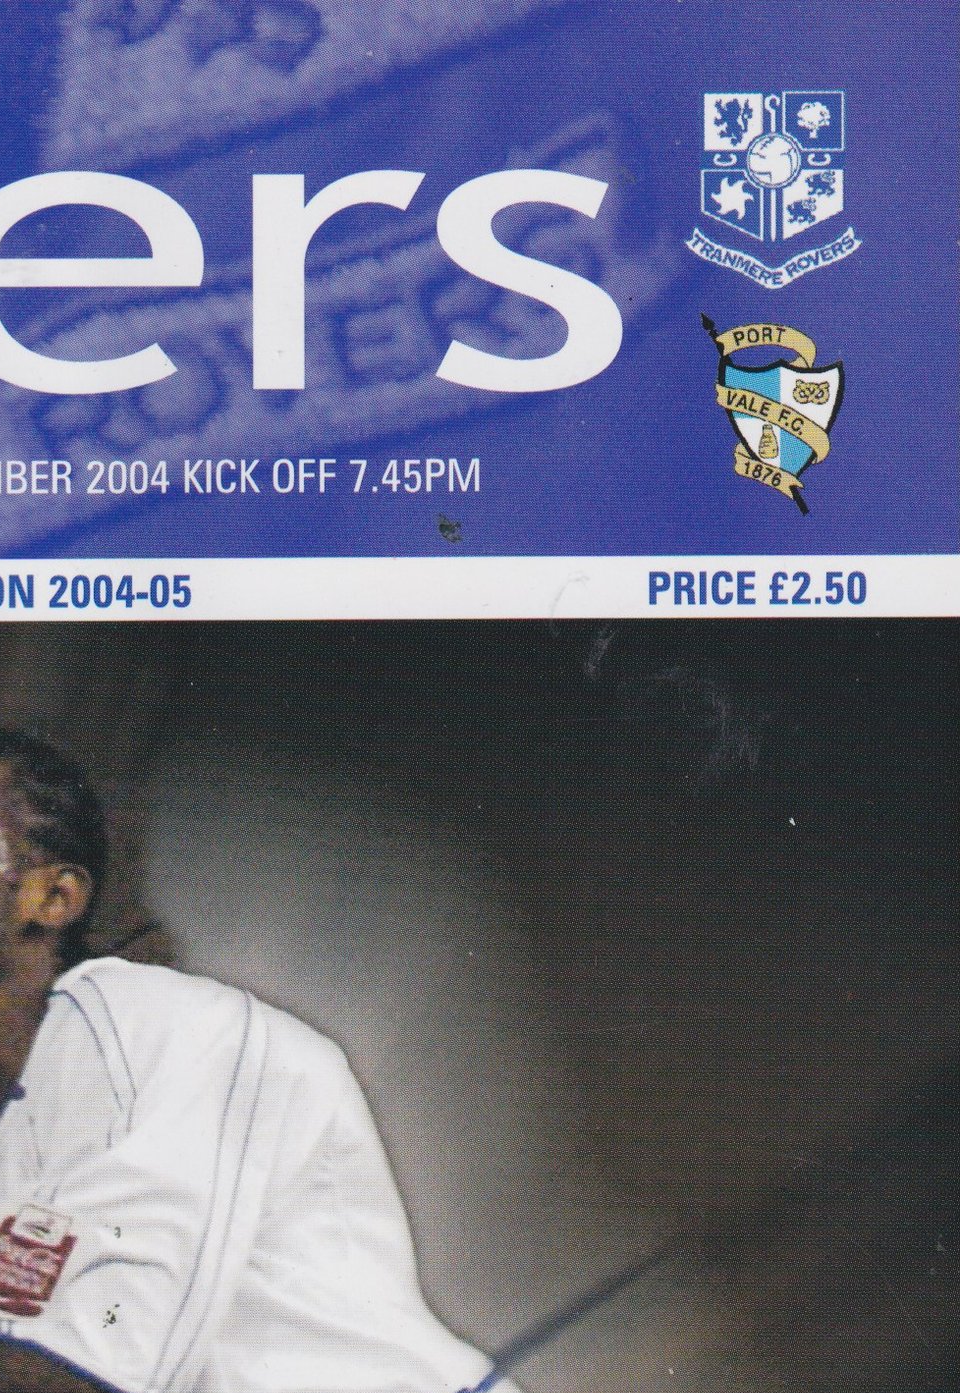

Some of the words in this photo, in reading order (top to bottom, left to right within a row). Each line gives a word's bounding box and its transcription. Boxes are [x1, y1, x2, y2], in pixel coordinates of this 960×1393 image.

[691, 233, 783, 286] TRANMERE
[785, 235, 855, 277] ROVERS
[732, 327, 786, 346] PORT
[726, 390, 772, 418] VALE
[777, 408, 805, 436] F.C.
[87, 461, 171, 496] 2004
[185, 460, 261, 495] KICK
[273, 459, 337, 494] OFF
[350, 459, 481, 494] 7.45PM
[743, 462, 782, 488] 1876
[49, 575, 193, 610] 2004-05
[649, 571, 757, 607] PRICE
[770, 572, 868, 607] £2.50
